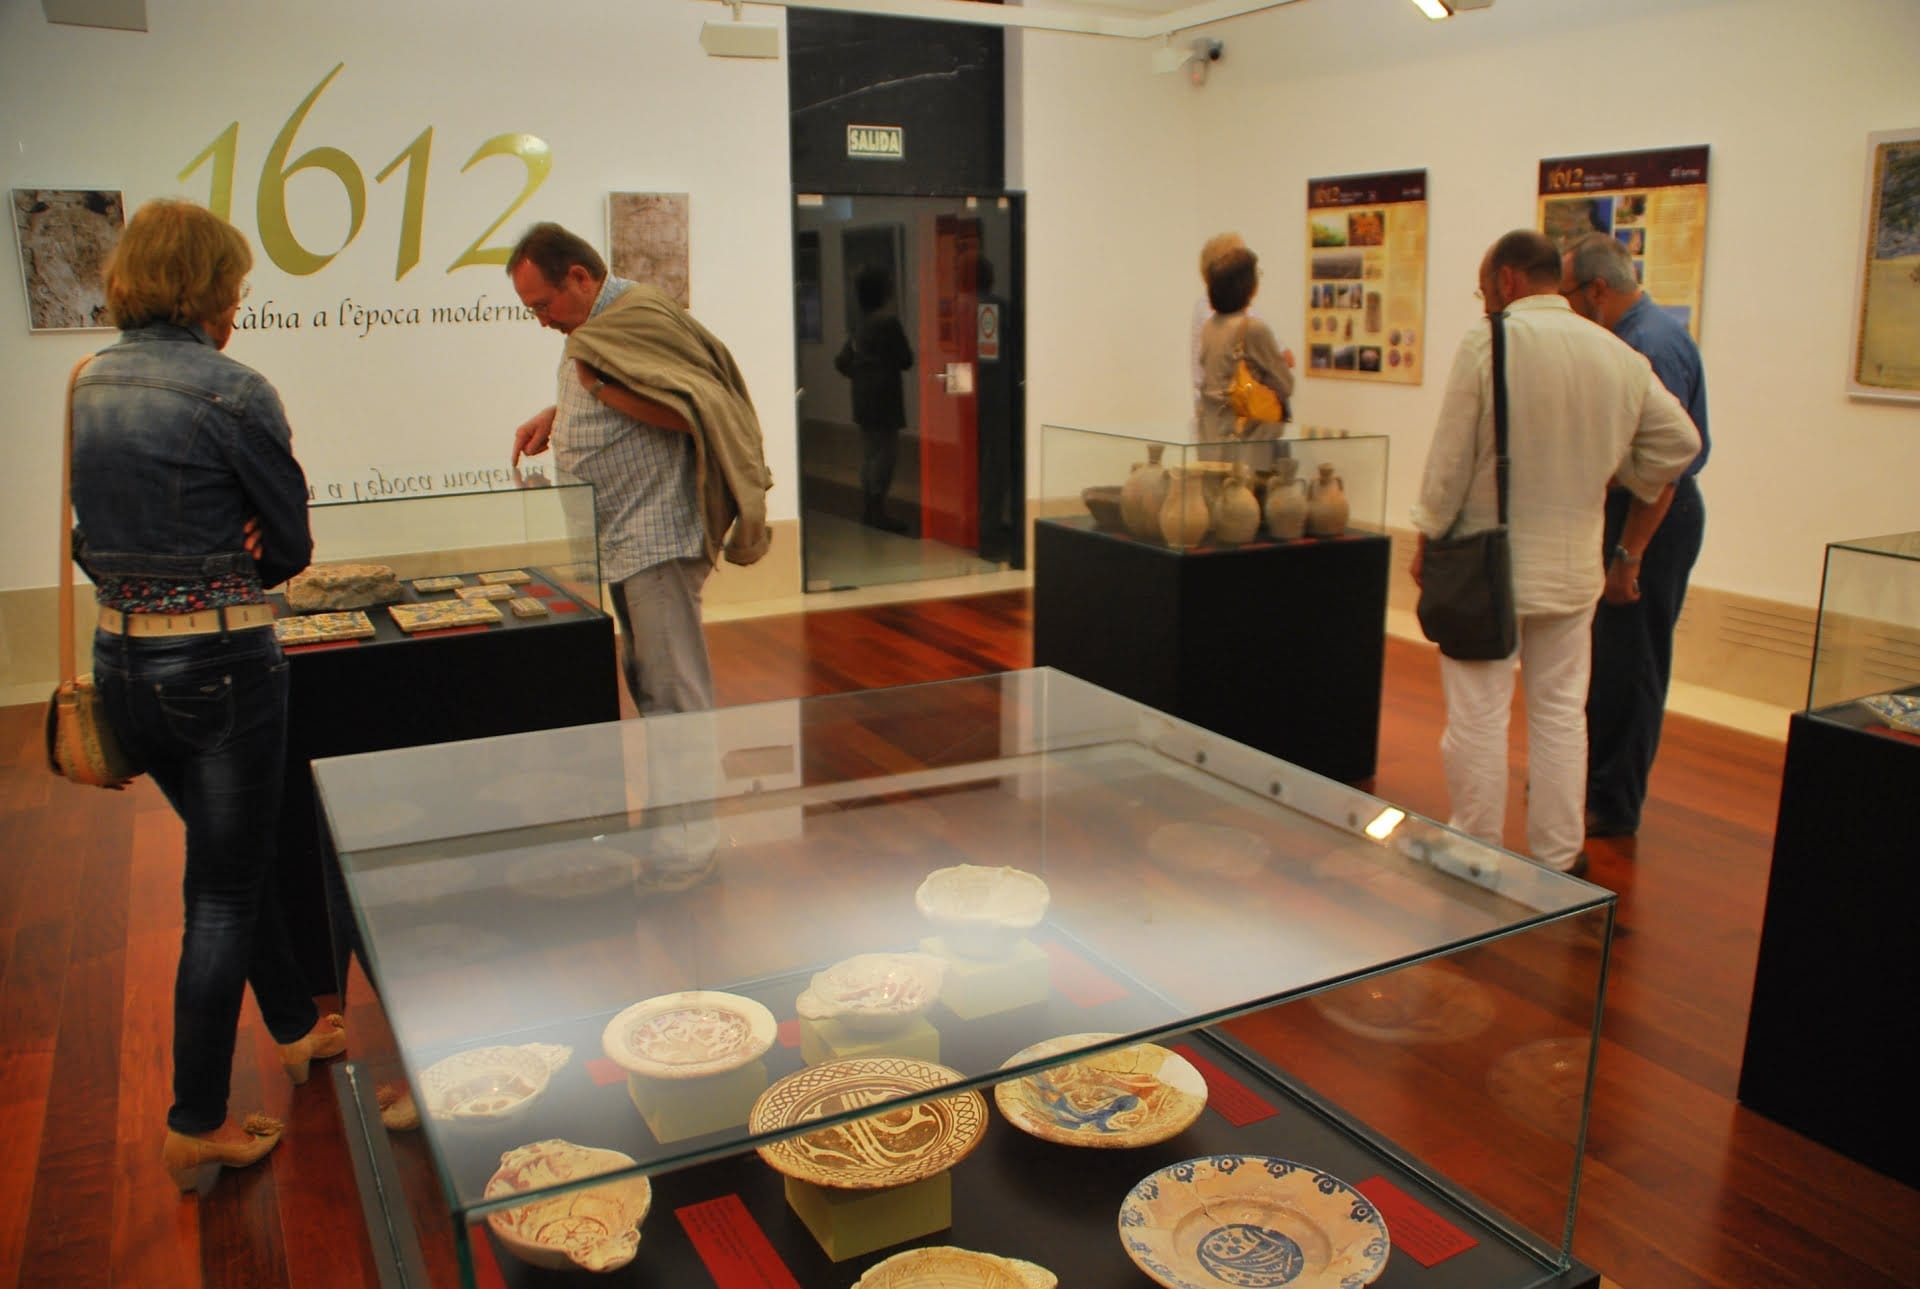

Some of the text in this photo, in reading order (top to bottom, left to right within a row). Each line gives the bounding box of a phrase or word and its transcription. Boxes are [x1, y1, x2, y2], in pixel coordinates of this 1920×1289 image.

[850, 129, 899, 152] SALIDA
[176, 61, 552, 281] 1612
[313, 309, 328, 328] a
[339, 298, 421, 339] l'època
